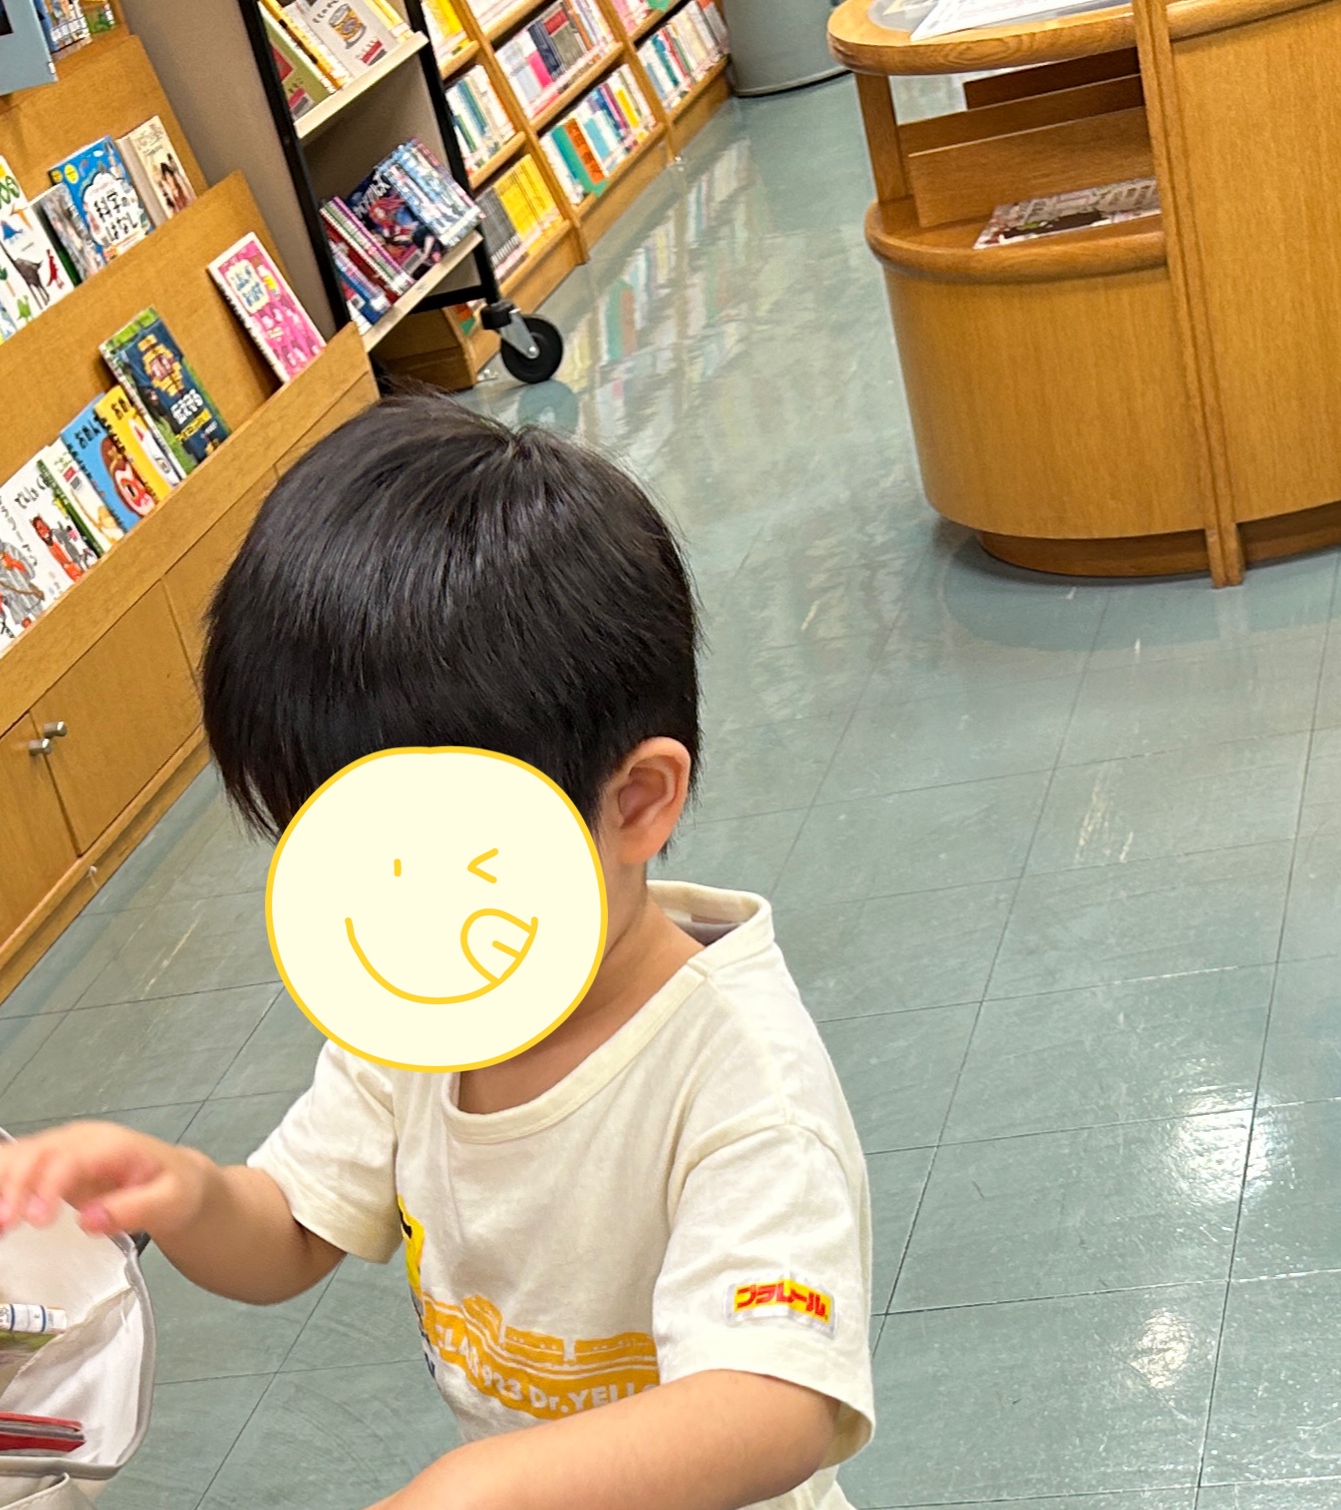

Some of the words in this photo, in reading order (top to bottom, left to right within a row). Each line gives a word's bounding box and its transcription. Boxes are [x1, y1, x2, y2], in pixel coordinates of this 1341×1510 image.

[734, 1280, 830, 1321] プラレール
[483, 1365, 522, 1401] 923
